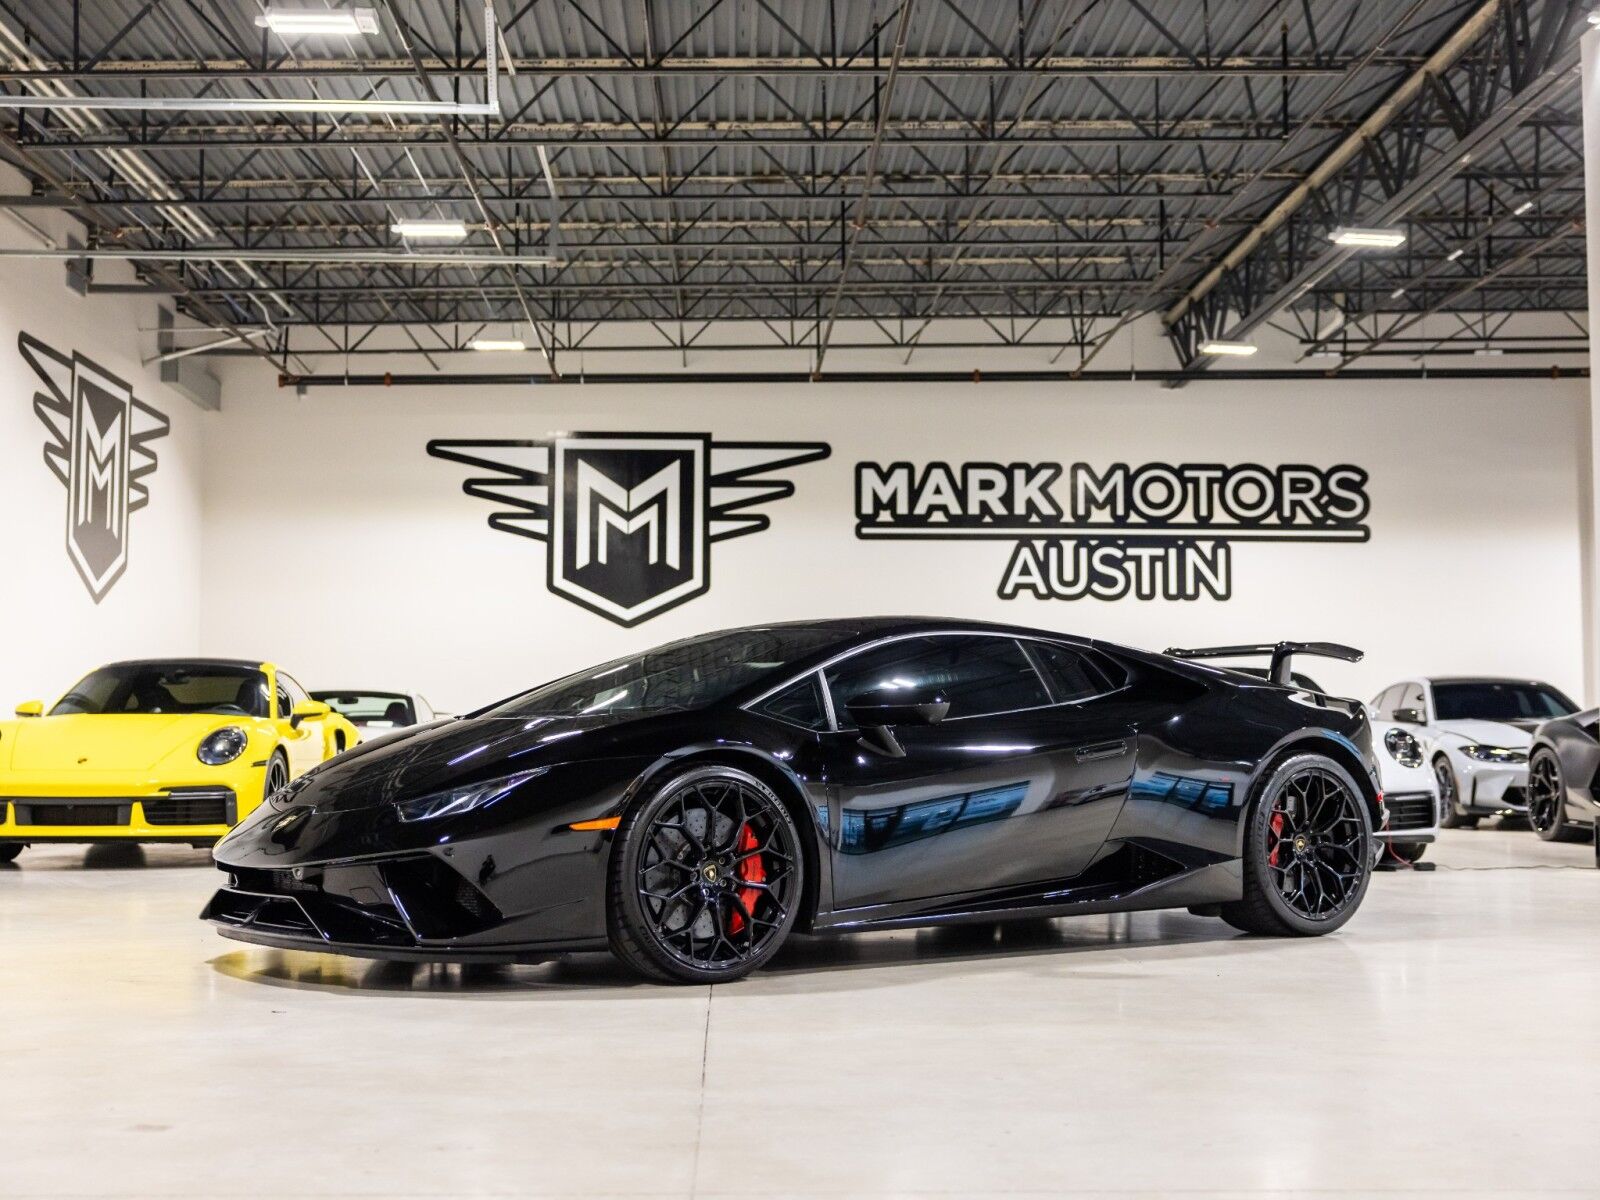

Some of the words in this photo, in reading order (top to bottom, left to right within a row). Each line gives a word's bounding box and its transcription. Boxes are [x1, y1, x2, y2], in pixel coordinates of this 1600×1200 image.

[859, 465, 1059, 517] MARK
[1074, 467, 1366, 520] MOTORS
[1002, 544, 1228, 598] AUSTIN
